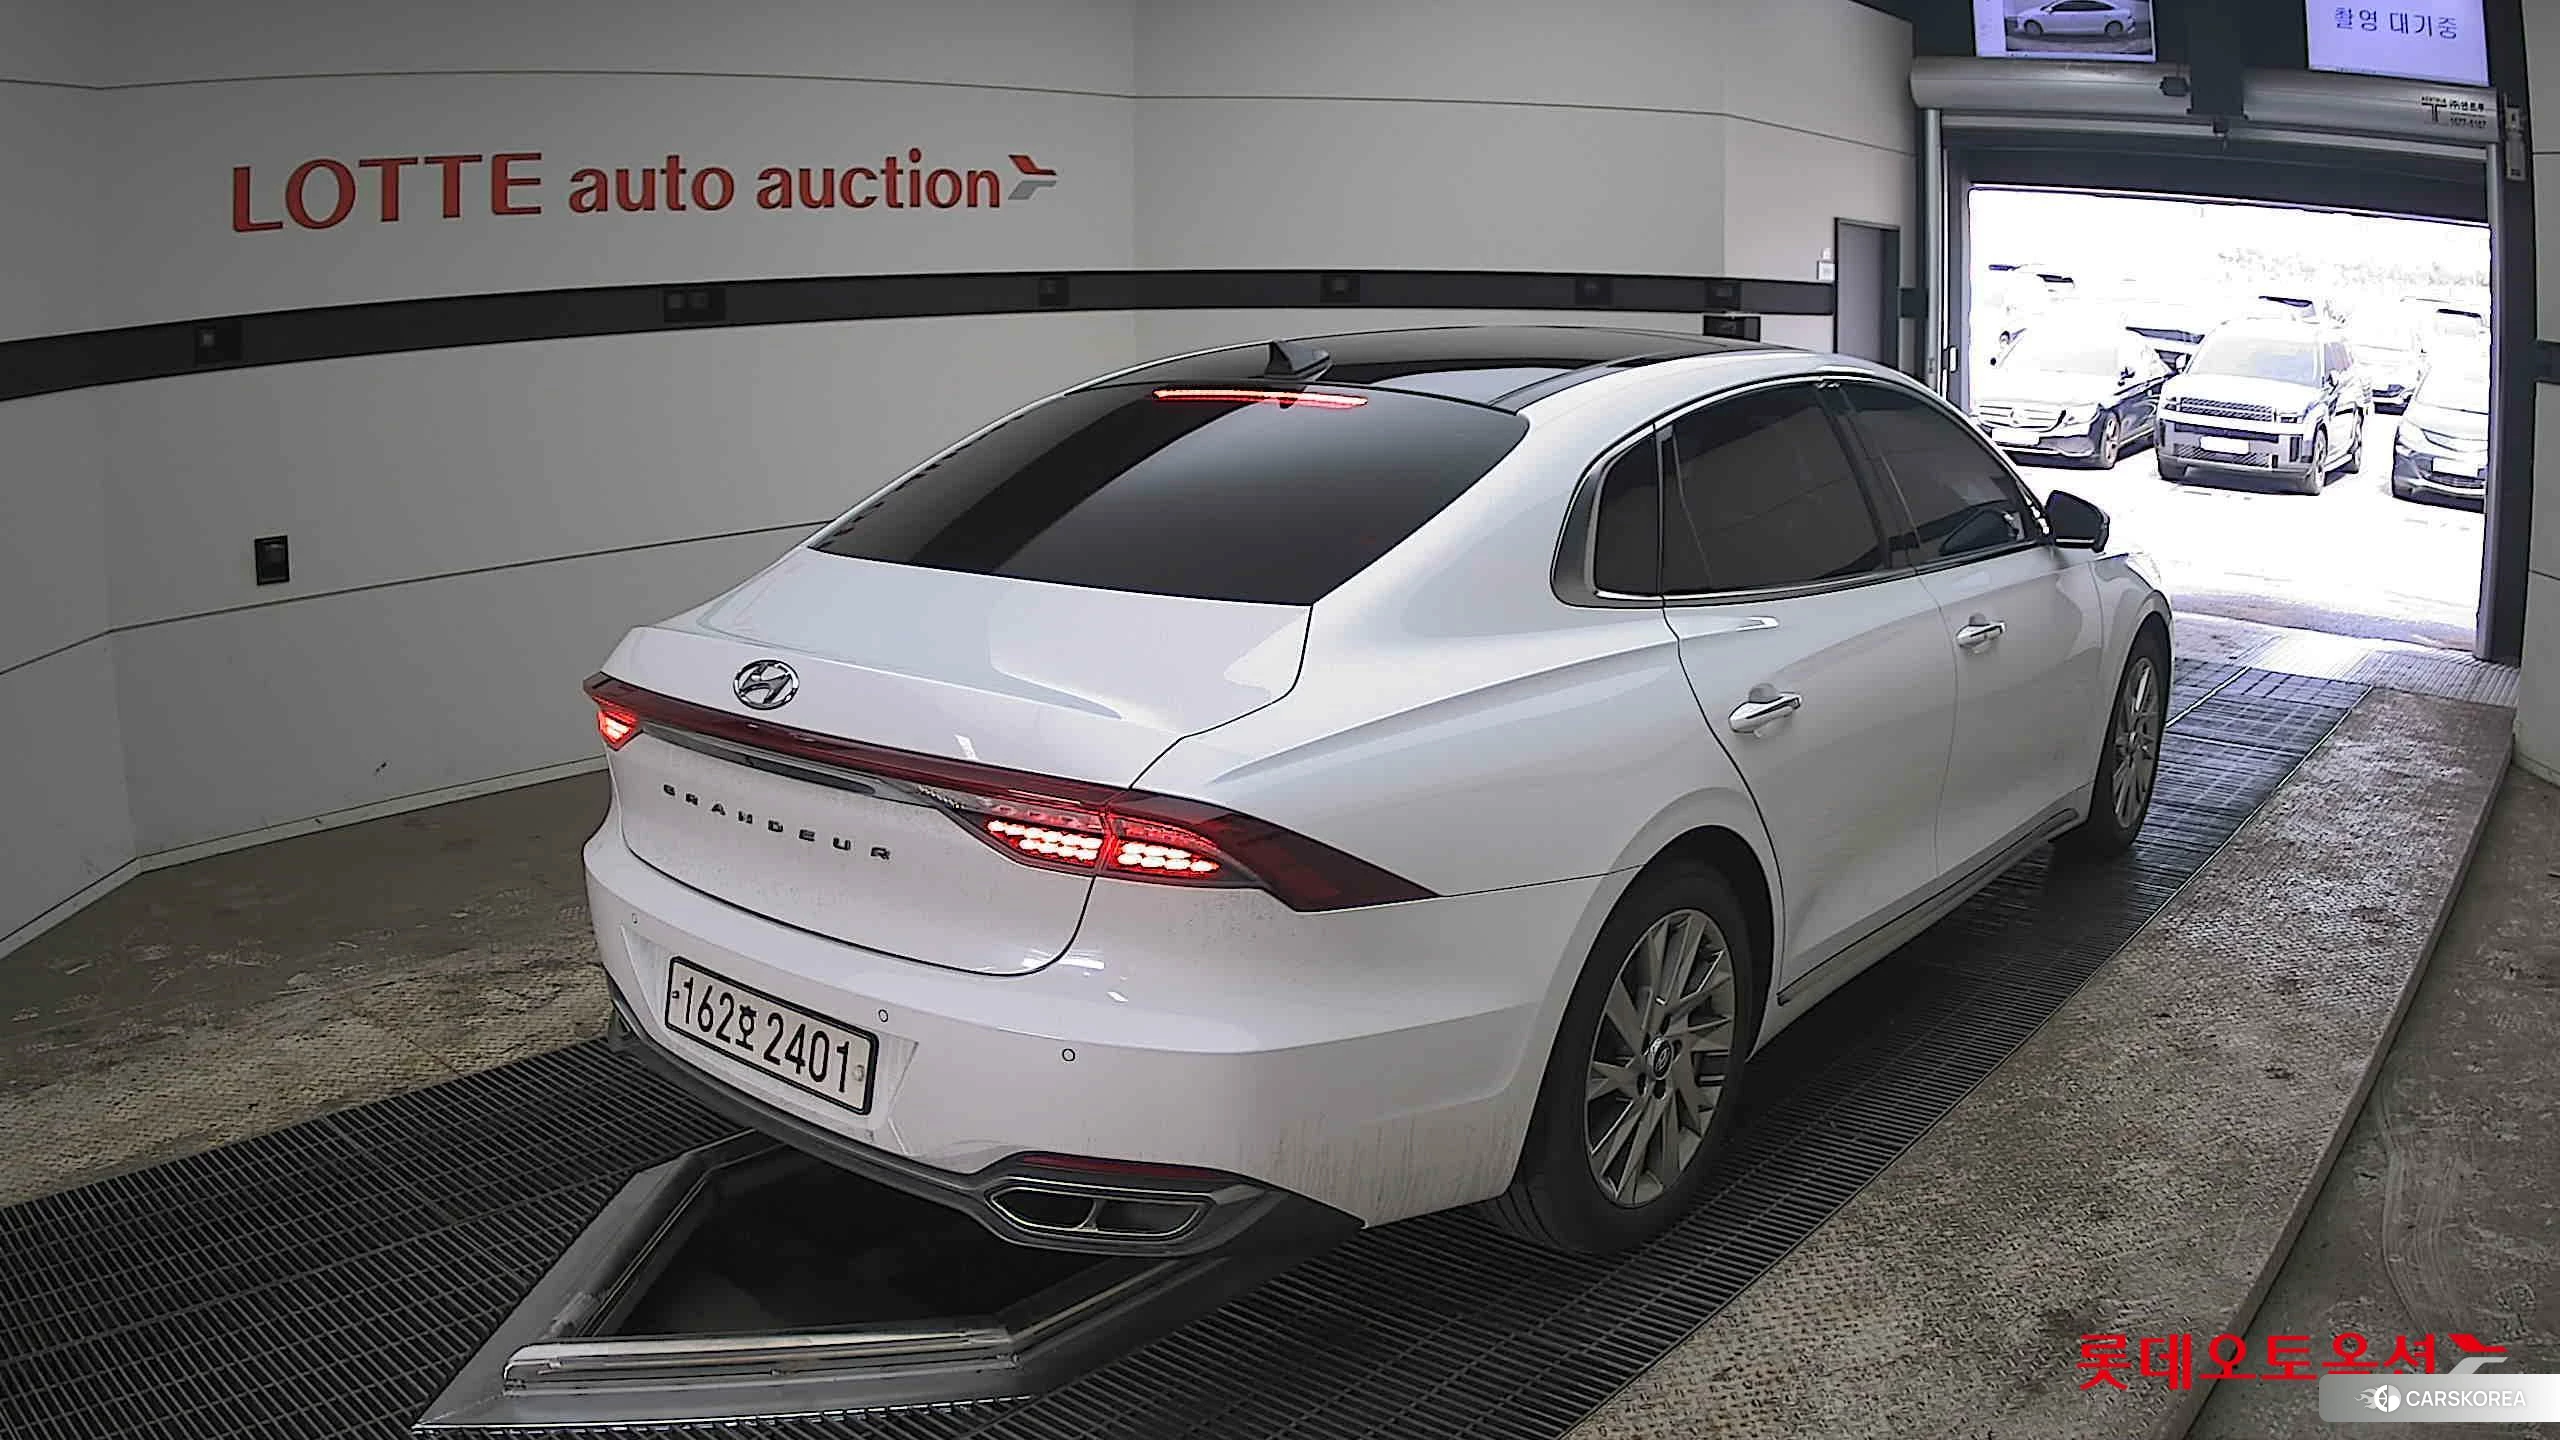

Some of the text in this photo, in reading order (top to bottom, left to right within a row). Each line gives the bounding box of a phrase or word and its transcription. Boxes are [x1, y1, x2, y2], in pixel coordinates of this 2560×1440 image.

[2335, 7, 2457, 40] 촬영 대기중
[233, 147, 1001, 233] LOTTE auto auction
[663, 784, 891, 861] GRANDEUR
[683, 977, 850, 1093] 162호 2401
